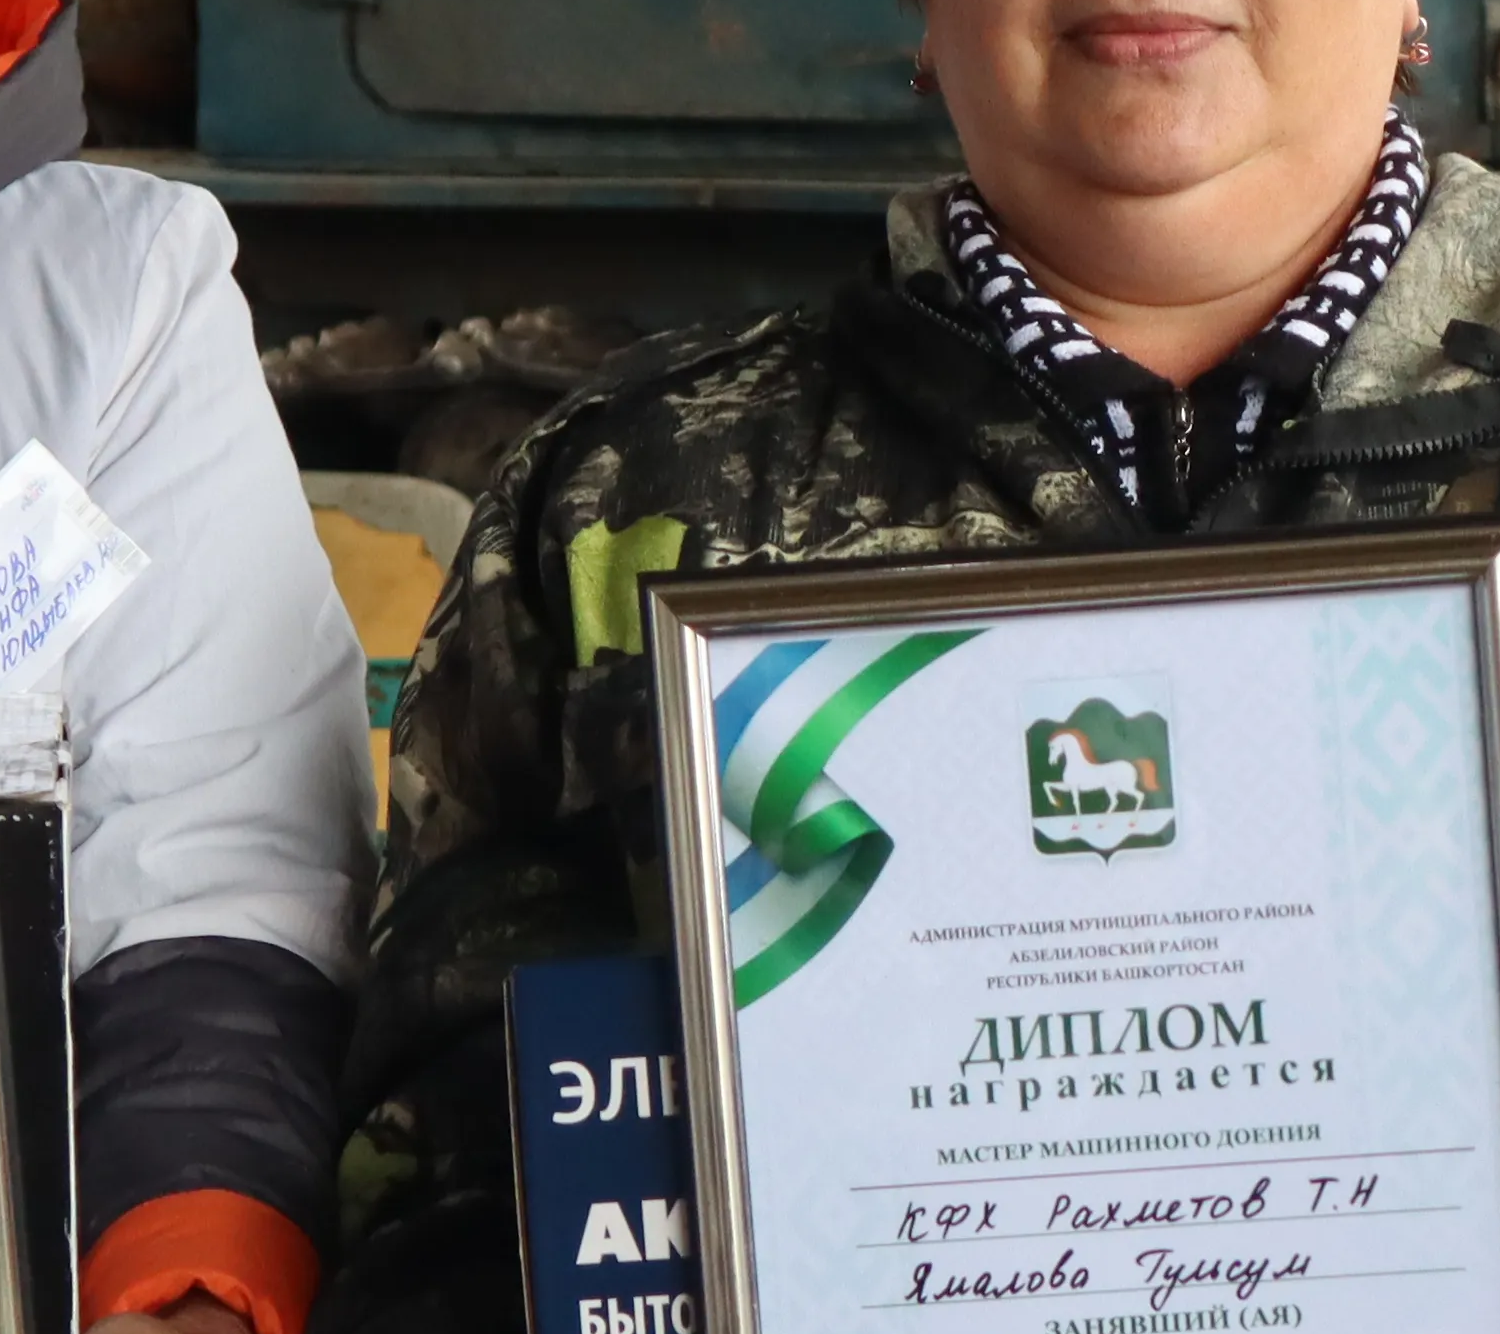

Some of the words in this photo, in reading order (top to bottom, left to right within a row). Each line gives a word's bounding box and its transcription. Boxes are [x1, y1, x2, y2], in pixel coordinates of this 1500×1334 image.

[909, 921, 1065, 943] АДМИНИСТРАЦИЯ
[1069, 908, 1239, 933] МУНИЦИПАЛЬНОГО
[1245, 903, 1315, 921] РАЙОНА
[1009, 940, 1155, 964] АБЗЕЛИЛОВСКИЙ
[1160, 936, 1219, 953] РАЙОН
[987, 968, 1098, 989] РЕСПУБЛИКИ
[1102, 960, 1245, 982] БАШКОРТОСТАН
[959, 998, 1268, 1076] ДИПЛОМ
[936, 1143, 1033, 1165] МАСТЕР
[1040, 1129, 1211, 1158] МАШИННОГО
[1217, 1123, 1321, 1148] ДОЕНИЯ
[898, 1200, 997, 1242] КФХ
[1047, 1177, 1271, 1231] Рахметов
[1239, 1304, 1303, 1332] (АЯ)
